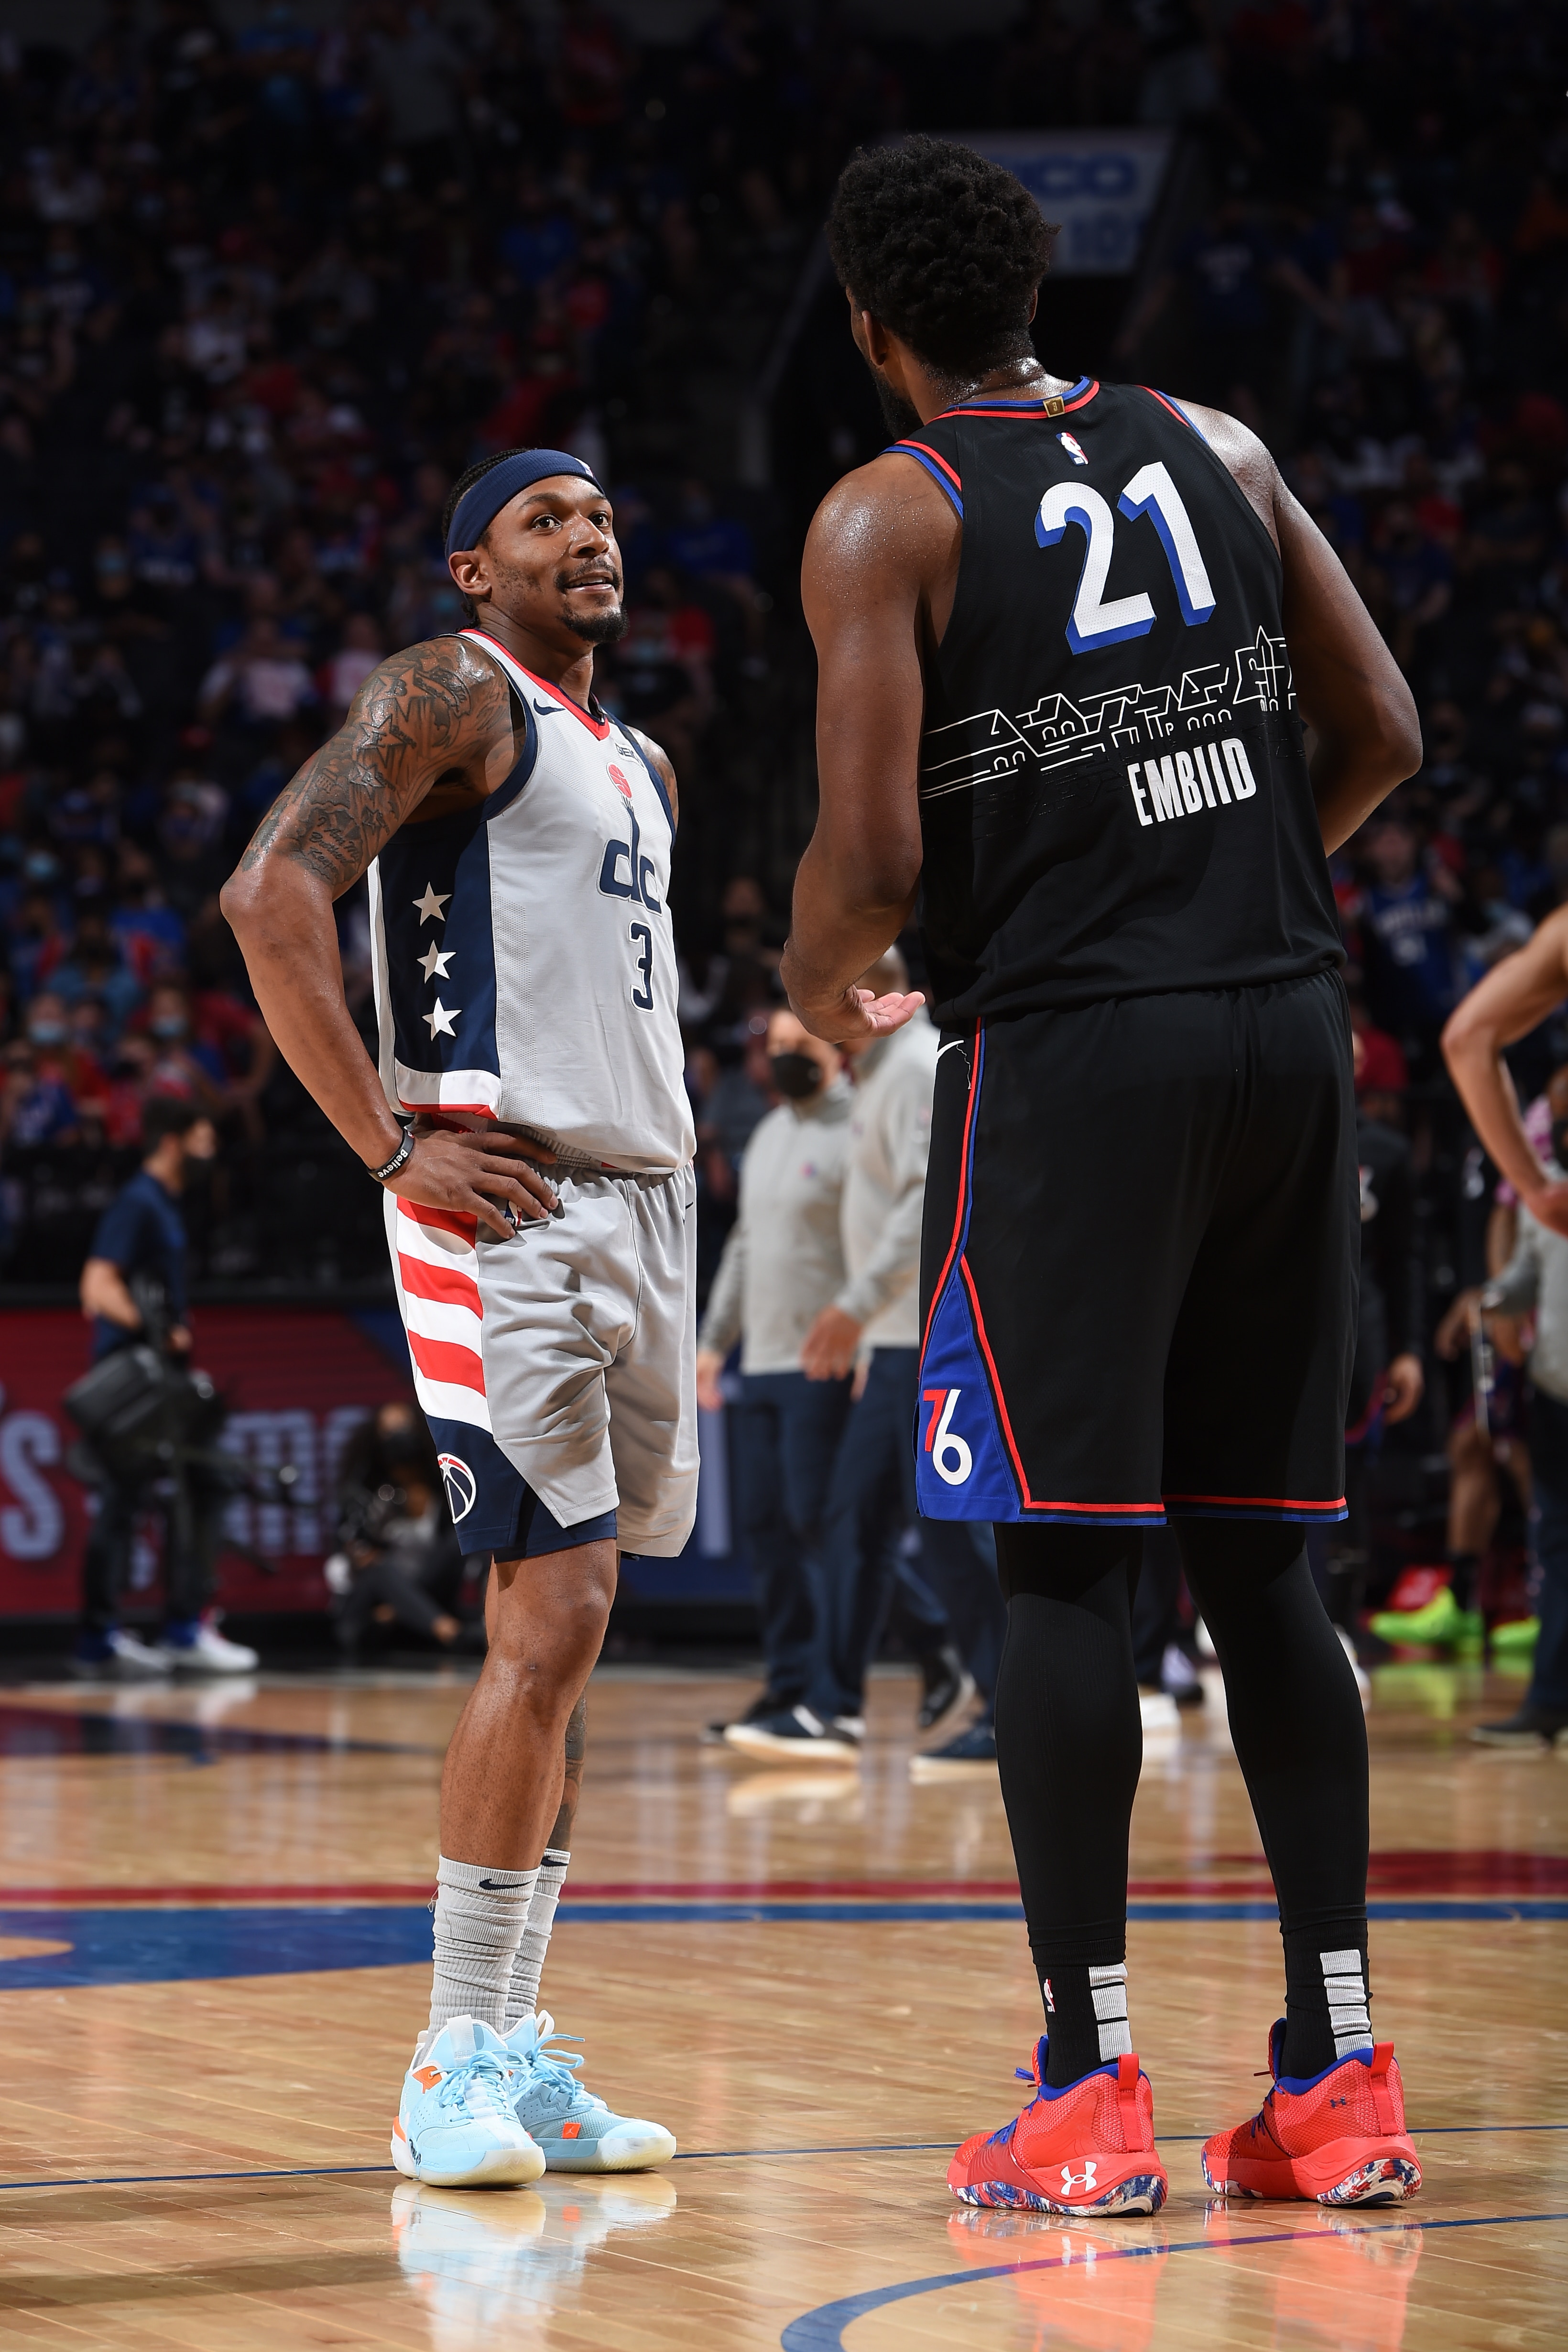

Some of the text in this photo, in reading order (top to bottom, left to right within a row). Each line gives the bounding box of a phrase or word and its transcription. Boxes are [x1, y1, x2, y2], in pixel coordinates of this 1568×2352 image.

[1035, 461, 1215, 655] 21
[1127, 737, 1257, 826] EMBIID
[597, 808, 663, 916] dc
[629, 919, 655, 1013] 3
[377, 1148, 409, 1177] Believe
[923, 1388, 973, 1486] 76
